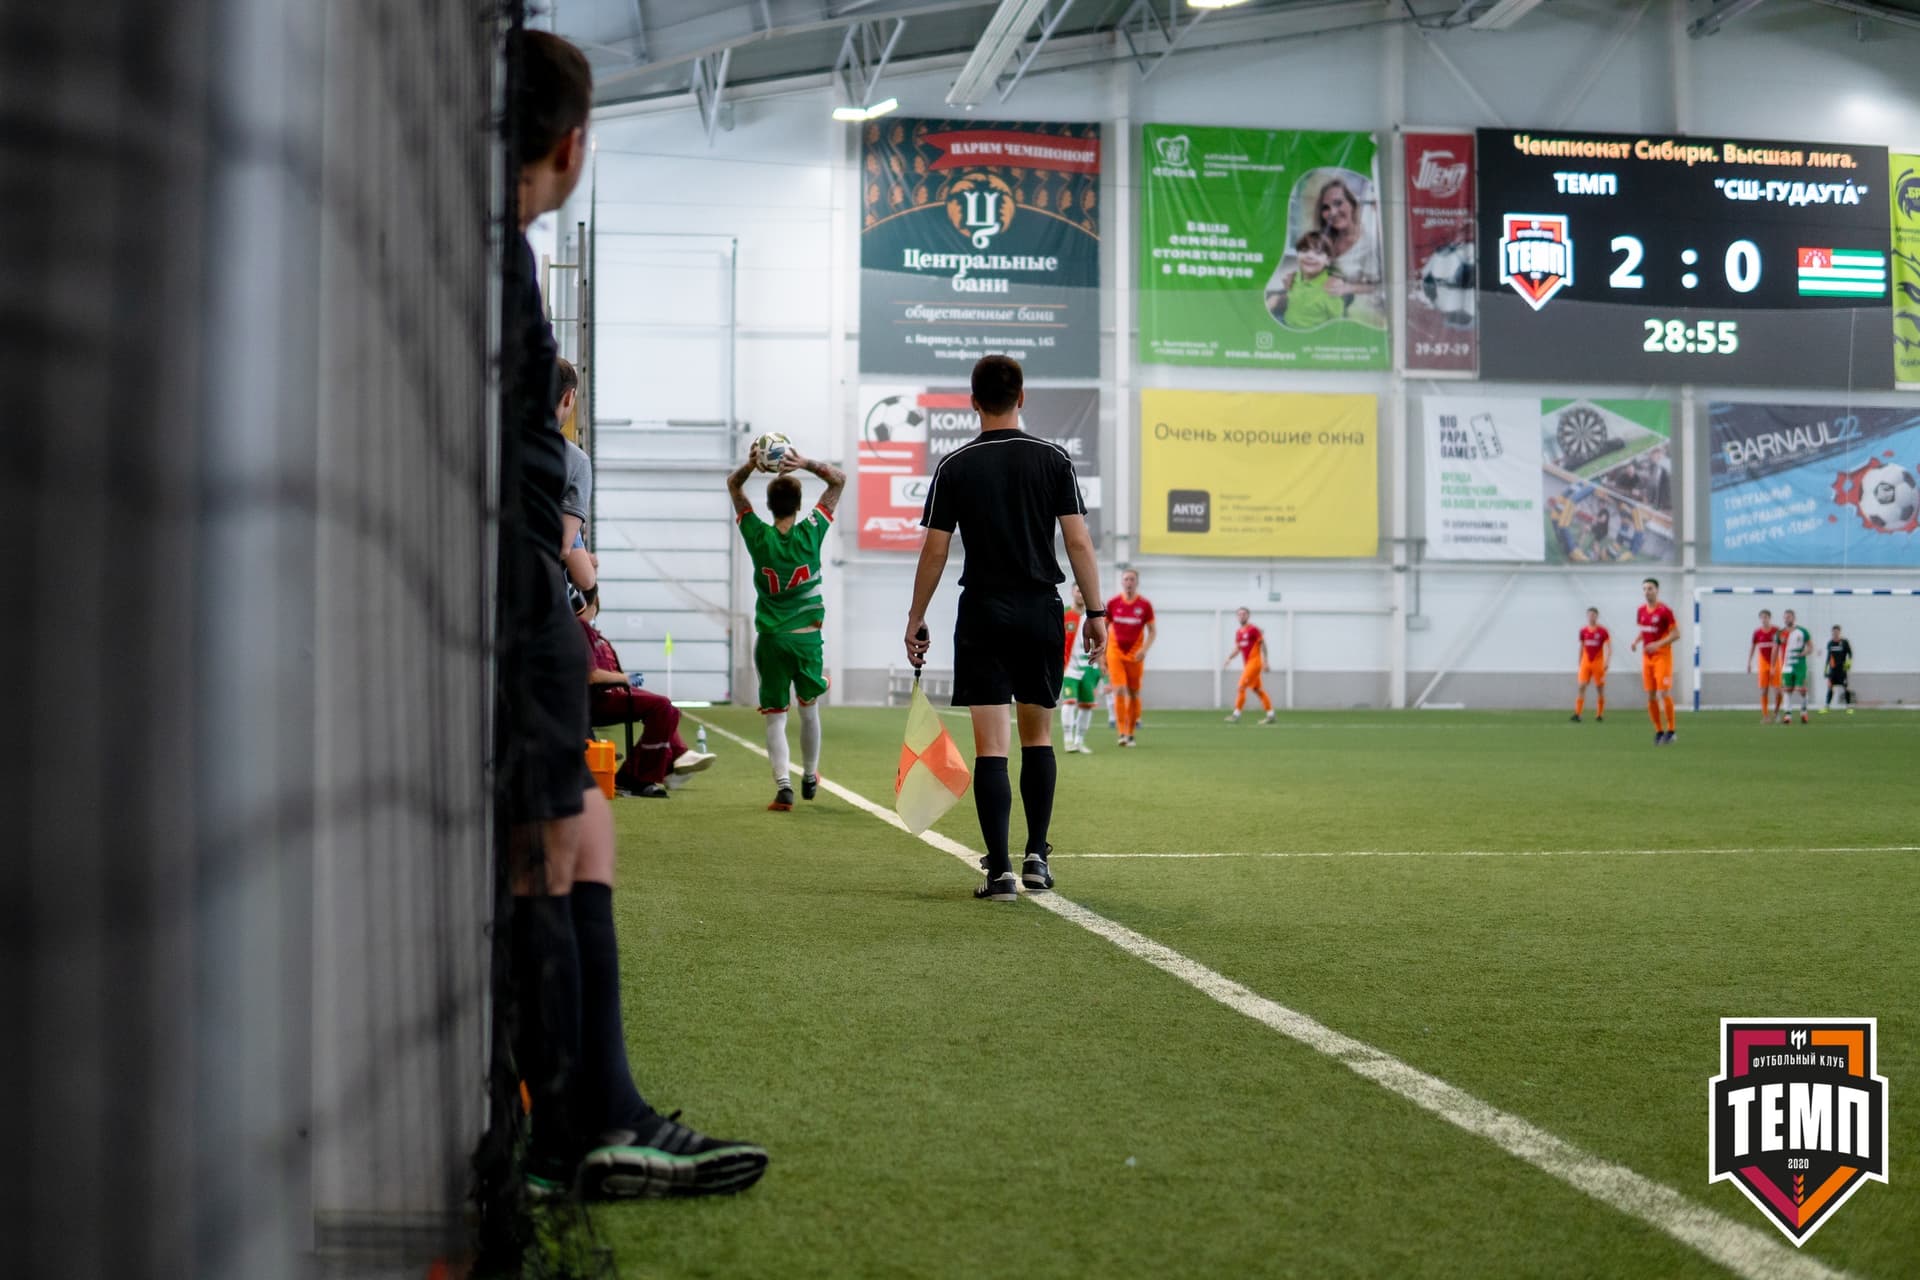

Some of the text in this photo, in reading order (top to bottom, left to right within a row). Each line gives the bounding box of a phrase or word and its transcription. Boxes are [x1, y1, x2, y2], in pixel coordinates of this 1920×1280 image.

[1514, 135, 1857, 168] Чемпионат Сибири. Высшая лига.
[1553, 172, 1617, 195] ТЕМП
[903, 248, 1058, 276] Центральные
[1609, 236, 1762, 292] 2 : 0
[952, 273, 1009, 293] бани
[1643, 319, 1739, 353] 28:55
[1154, 422, 1364, 447] Очень хорошие окна
[1440, 431, 1467, 443] PAPA
